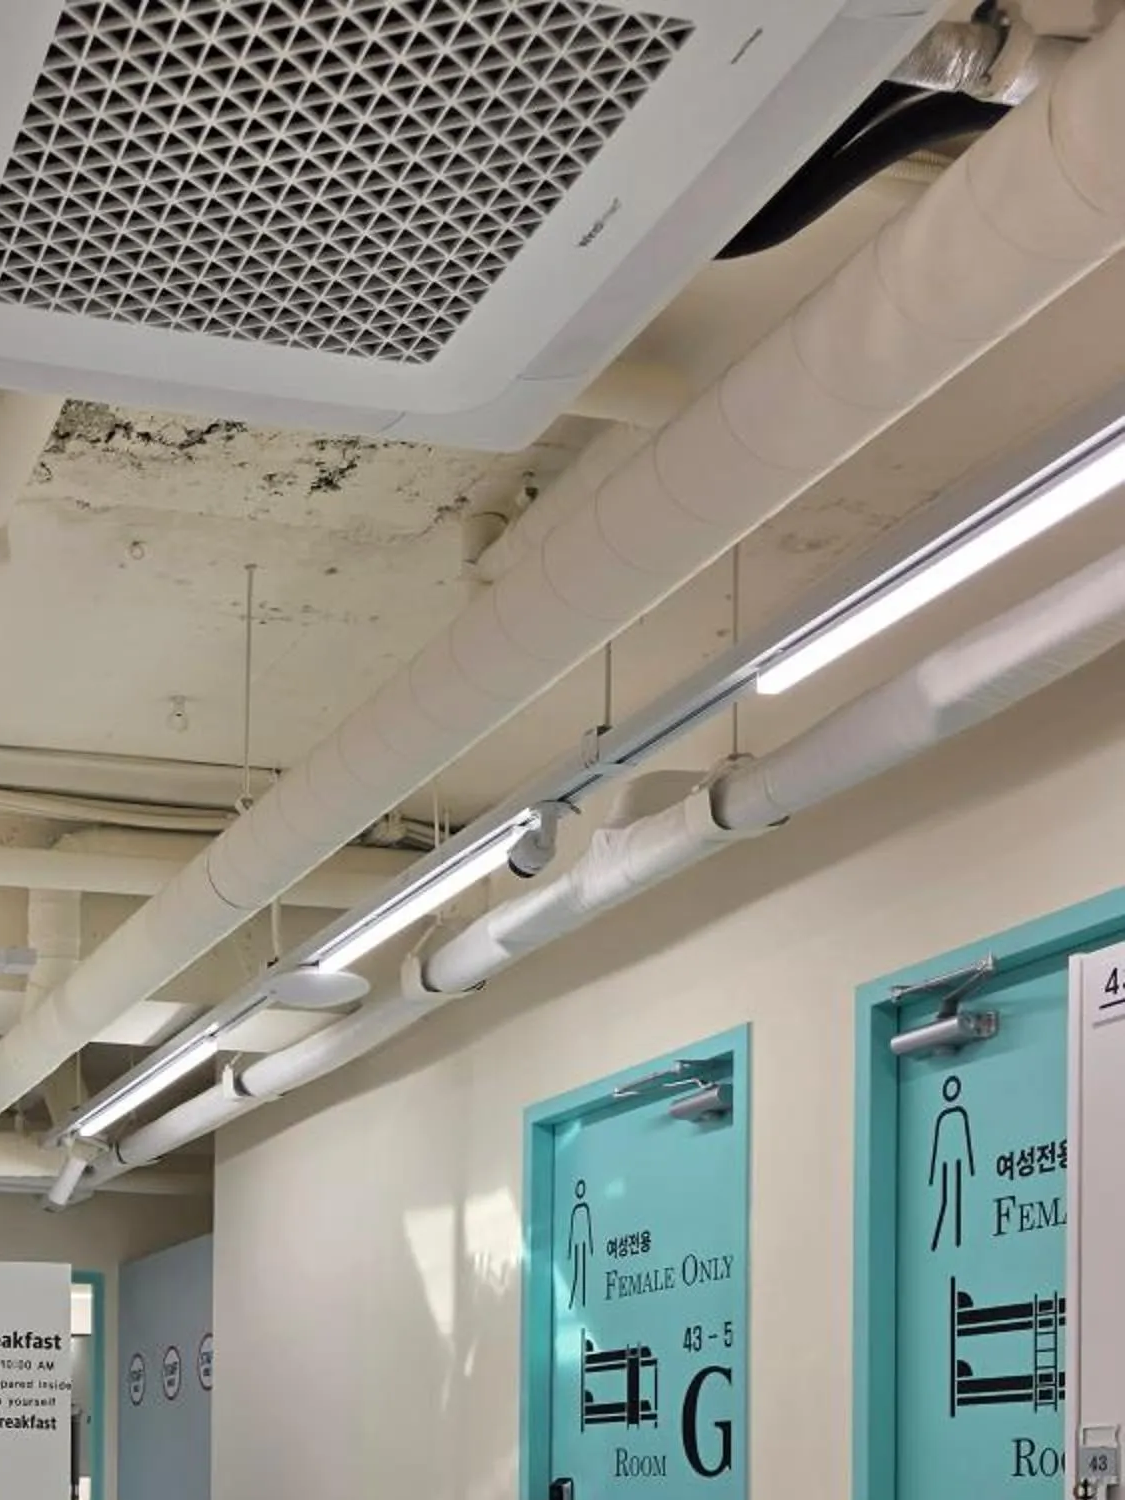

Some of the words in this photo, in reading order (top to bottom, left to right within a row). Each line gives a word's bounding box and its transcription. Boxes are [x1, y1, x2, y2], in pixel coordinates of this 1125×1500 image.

[1104, 967, 1125, 995] 4
[992, 1195, 1067, 1237] FEM
[606, 1230, 651, 1259] 여성전용
[605, 1267, 675, 1300] FEMALE
[682, 1253, 734, 1287] ONLY
[683, 1325, 702, 1352] 43
[724, 1321, 732, 1348] 5
[37, 1361, 54, 1371] AM
[8, 1397, 56, 1408] yourself
[615, 1447, 666, 1477] ROOM
[682, 1365, 732, 1478] G
[1011, 1437, 1065, 1477] RO
[1088, 1455, 1107, 1471] 43
